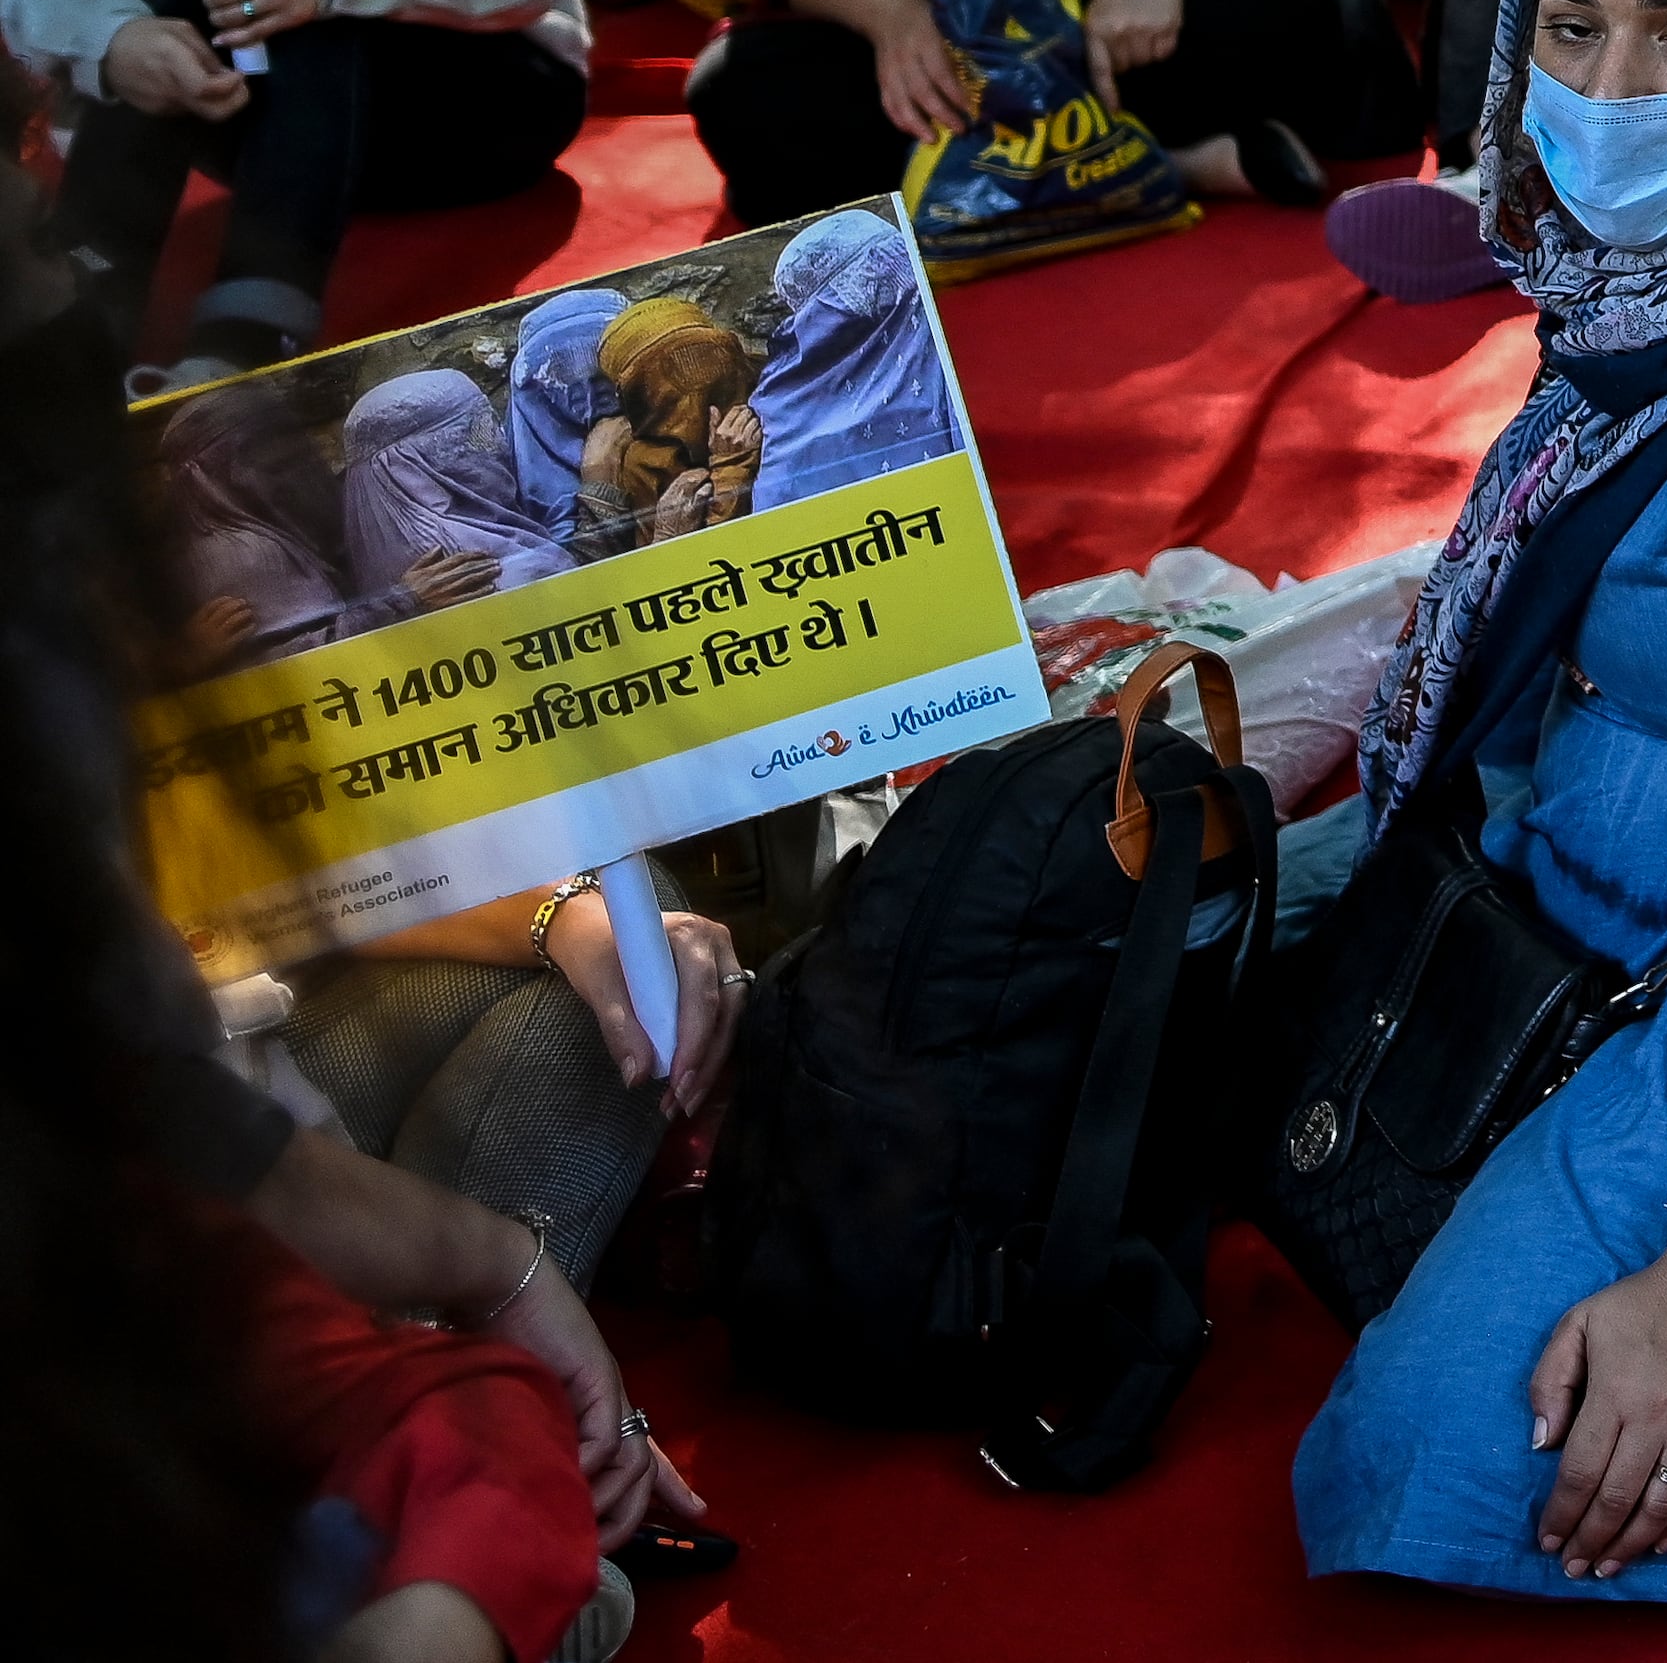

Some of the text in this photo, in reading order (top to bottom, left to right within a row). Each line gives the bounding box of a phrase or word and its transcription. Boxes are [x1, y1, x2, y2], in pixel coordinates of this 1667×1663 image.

[313, 676, 364, 729] ने
[371, 647, 499, 718] 1400
[501, 606, 620, 672] साल
[623, 558, 748, 634] पहले
[329, 722, 483, 801] समान
[490, 653, 700, 755] अधिकार
[700, 624, 792, 688] दिए
[800, 599, 849, 651] थे
[315, 869, 393, 905] Refugee
[340, 872, 451, 919] Association
